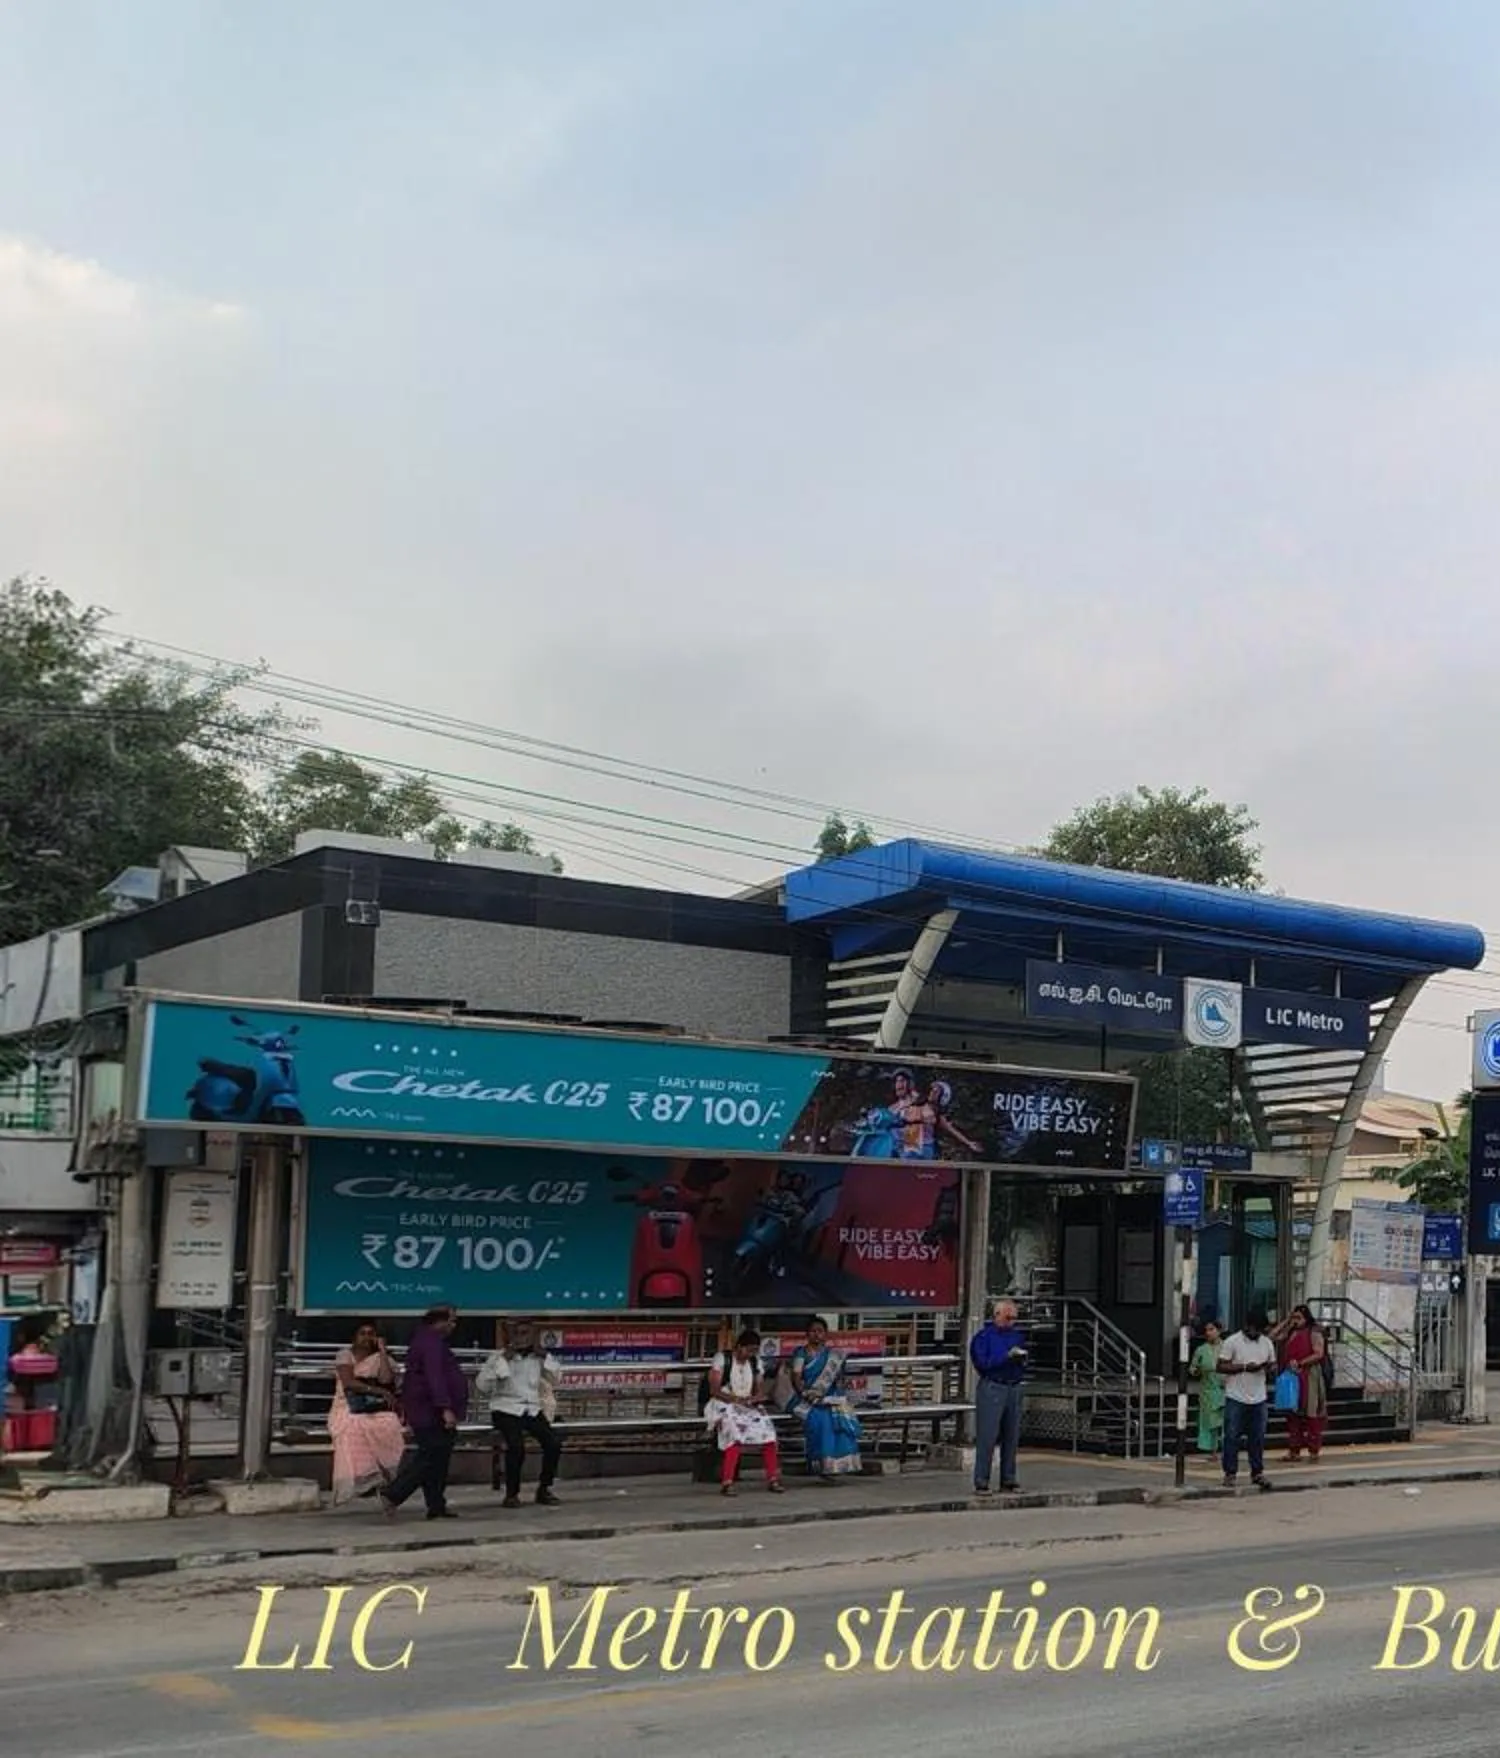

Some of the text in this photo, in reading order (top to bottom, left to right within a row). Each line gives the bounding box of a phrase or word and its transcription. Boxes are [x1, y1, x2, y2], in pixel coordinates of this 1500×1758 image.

[1107, 986, 1173, 1015] மெட்ரோ
[1264, 1007, 1344, 1032] LIC Metro
[332, 1069, 611, 1108] Chetak C25
[658, 1075, 760, 1093] EARLY BIRD PRICE
[993, 1093, 1088, 1115] RIDE EASY
[1010, 1111, 1102, 1135] VIBE EASY
[333, 1176, 589, 1205] Chetak C25
[399, 1213, 533, 1230] EARLY BIRD PRICE
[839, 1227, 926, 1245] RIDE EASY
[856, 1243, 941, 1262] VIBE EASY
